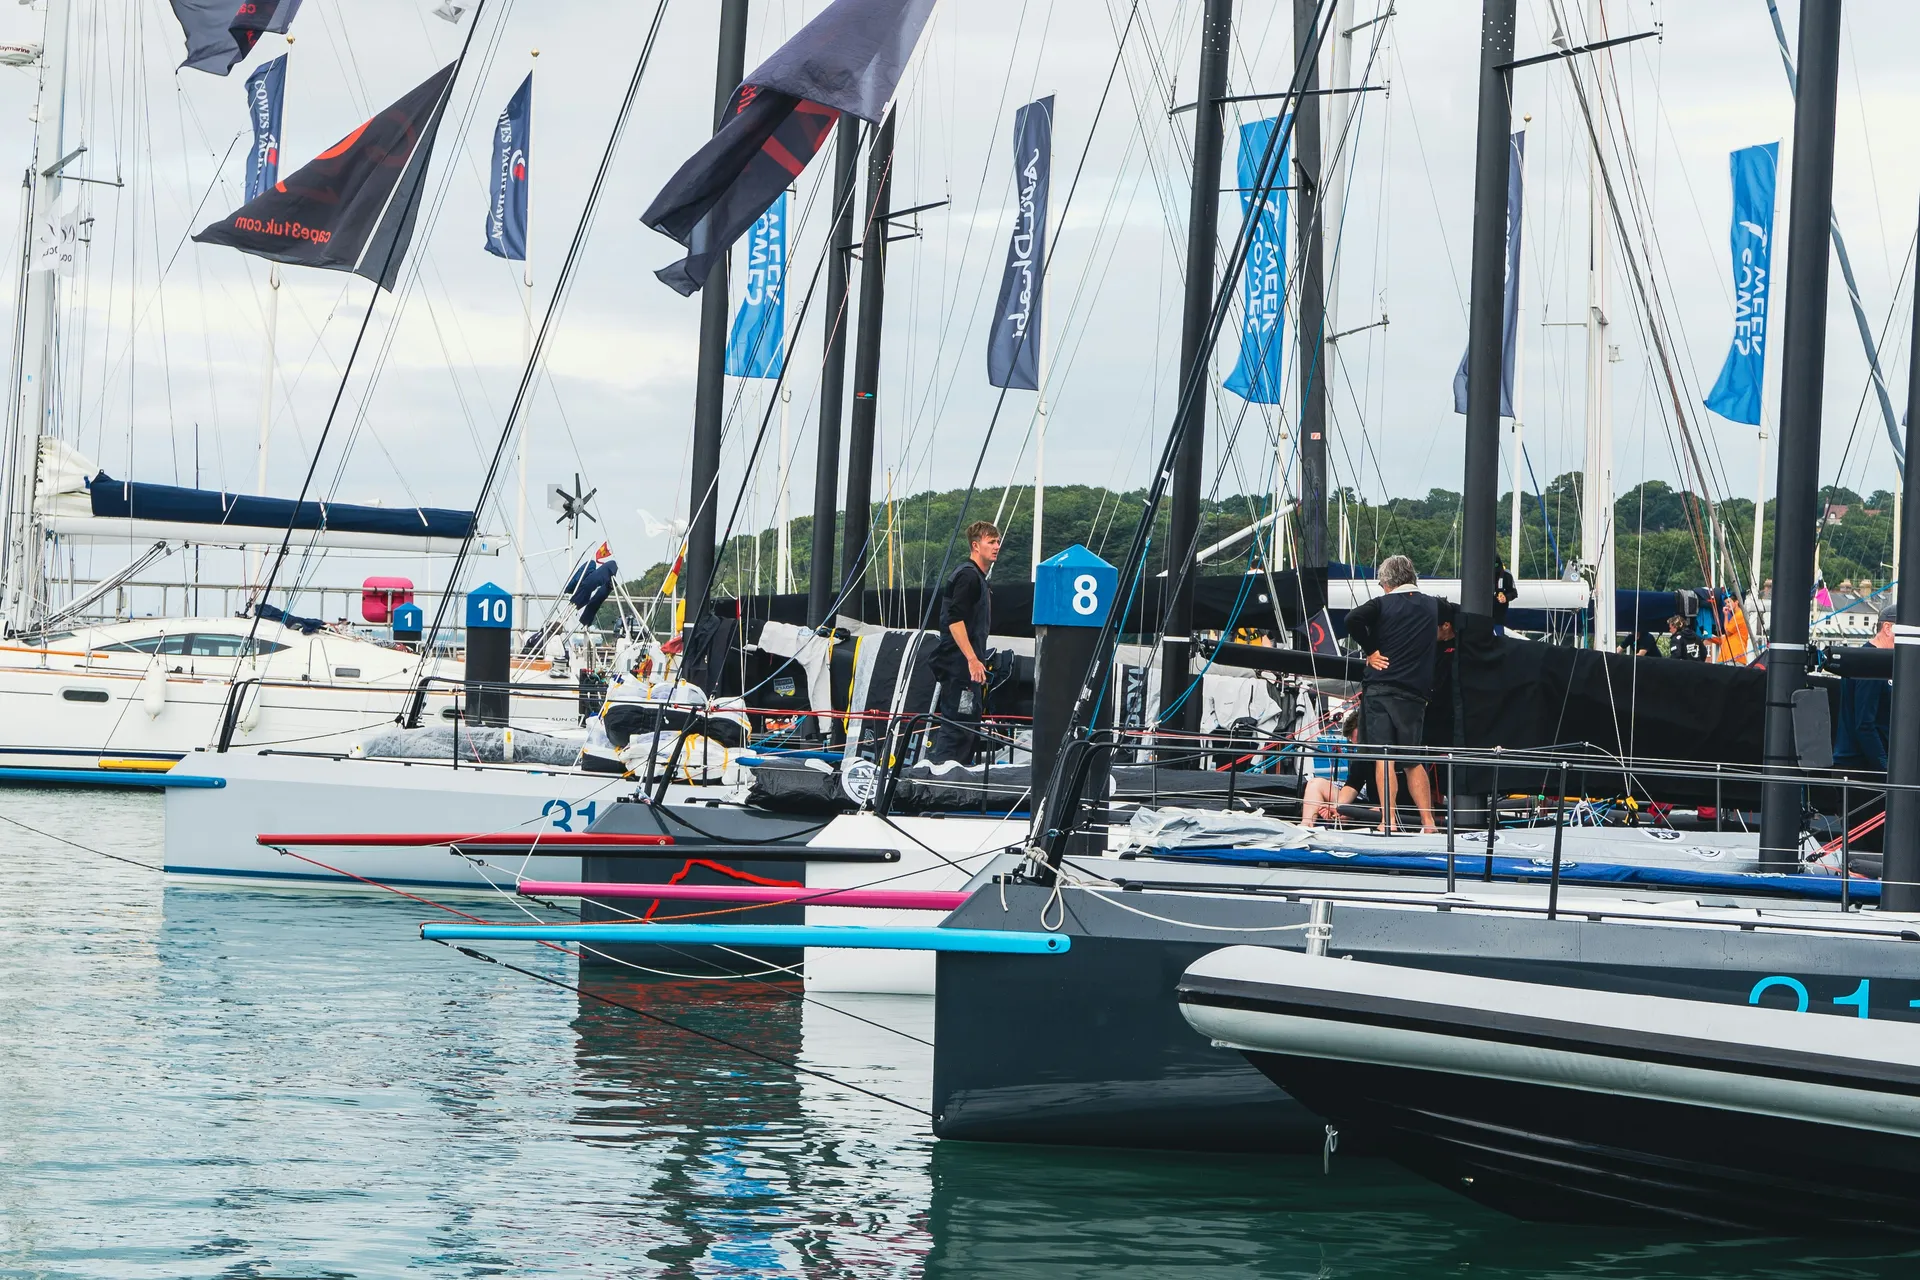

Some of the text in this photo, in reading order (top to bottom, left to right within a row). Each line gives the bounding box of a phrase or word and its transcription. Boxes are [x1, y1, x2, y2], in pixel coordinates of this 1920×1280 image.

[0, 46, 31, 55] aymarine
[254, 80, 270, 130] COWES
[478, 598, 507, 622] 10
[1072, 574, 1098, 616] 8
[404, 611, 412, 627] 1
[1126, 666, 1145, 728] DOYL
